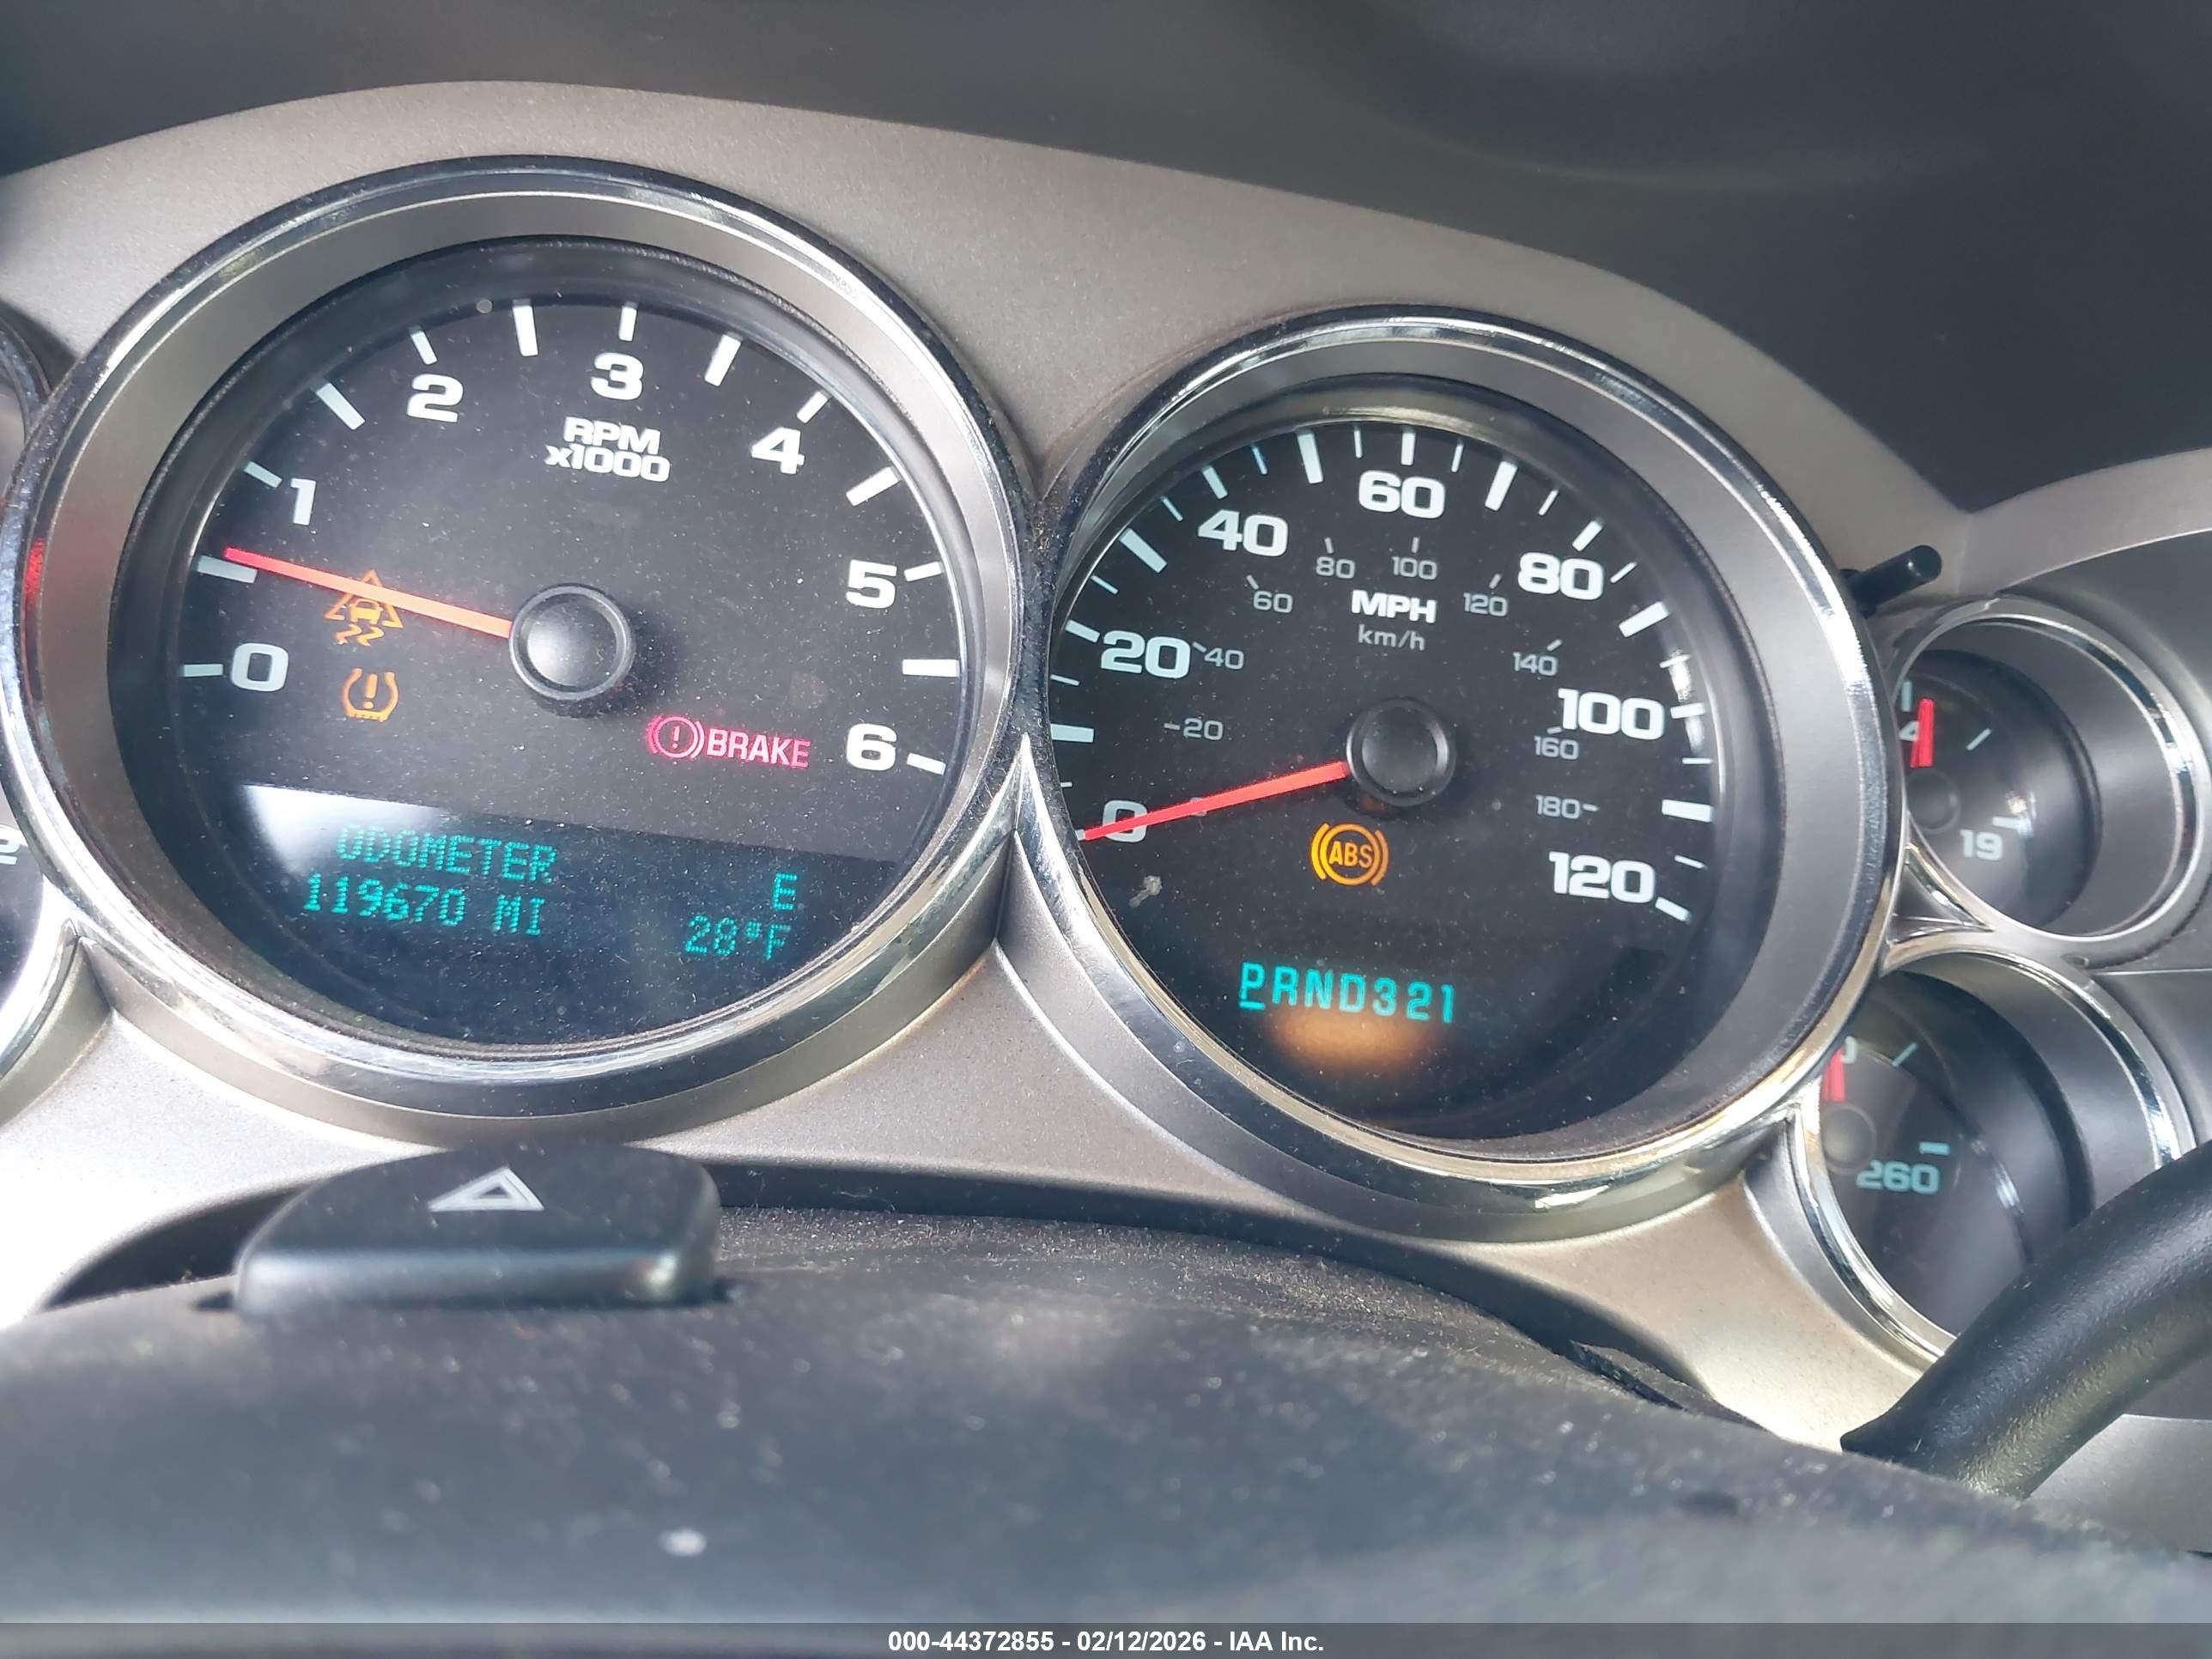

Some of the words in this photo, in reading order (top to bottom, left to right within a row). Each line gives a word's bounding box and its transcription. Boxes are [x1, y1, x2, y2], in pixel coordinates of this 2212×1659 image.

[591, 353, 644, 400] 3
[407, 374, 465, 422] 2
[562, 416, 661, 455] RPM
[750, 427, 805, 475] 4
[544, 445, 671, 483] x1000
[290, 478, 317, 526] 1
[1358, 470, 1446, 520] 60
[1198, 509, 1289, 557] 40
[846, 559, 898, 609] 5
[1316, 556, 1356, 580] 80
[1392, 556, 1438, 580] 100
[1517, 552, 1604, 601] 80
[1253, 591, 1293, 614] 60
[1352, 590, 1437, 624] MPH
[1463, 592, 1509, 617] 120
[1101, 630, 1191, 679] 20
[1358, 624, 1425, 652] km/h
[231, 642, 289, 691] 0
[1204, 647, 1244, 671] 40
[1513, 652, 1558, 677] 140
[1183, 718, 1224, 741] 20
[1558, 688, 1665, 741] 100
[706, 728, 811, 769] BRAKE
[846, 723, 897, 771] 6
[1534, 735, 1579, 761] 160
[1103, 799, 1147, 842] 0
[1536, 794, 1581, 820] 180
[337, 824, 557, 884] ODOMETER
[1328, 841, 1373, 869] ABS
[1960, 829, 2004, 861] 19
[773, 872, 798, 913] E
[1548, 851, 1656, 904] 120
[303, 872, 465, 927] 119670
[490, 894, 545, 937] MI
[1856, 1160, 1940, 1194] 260
